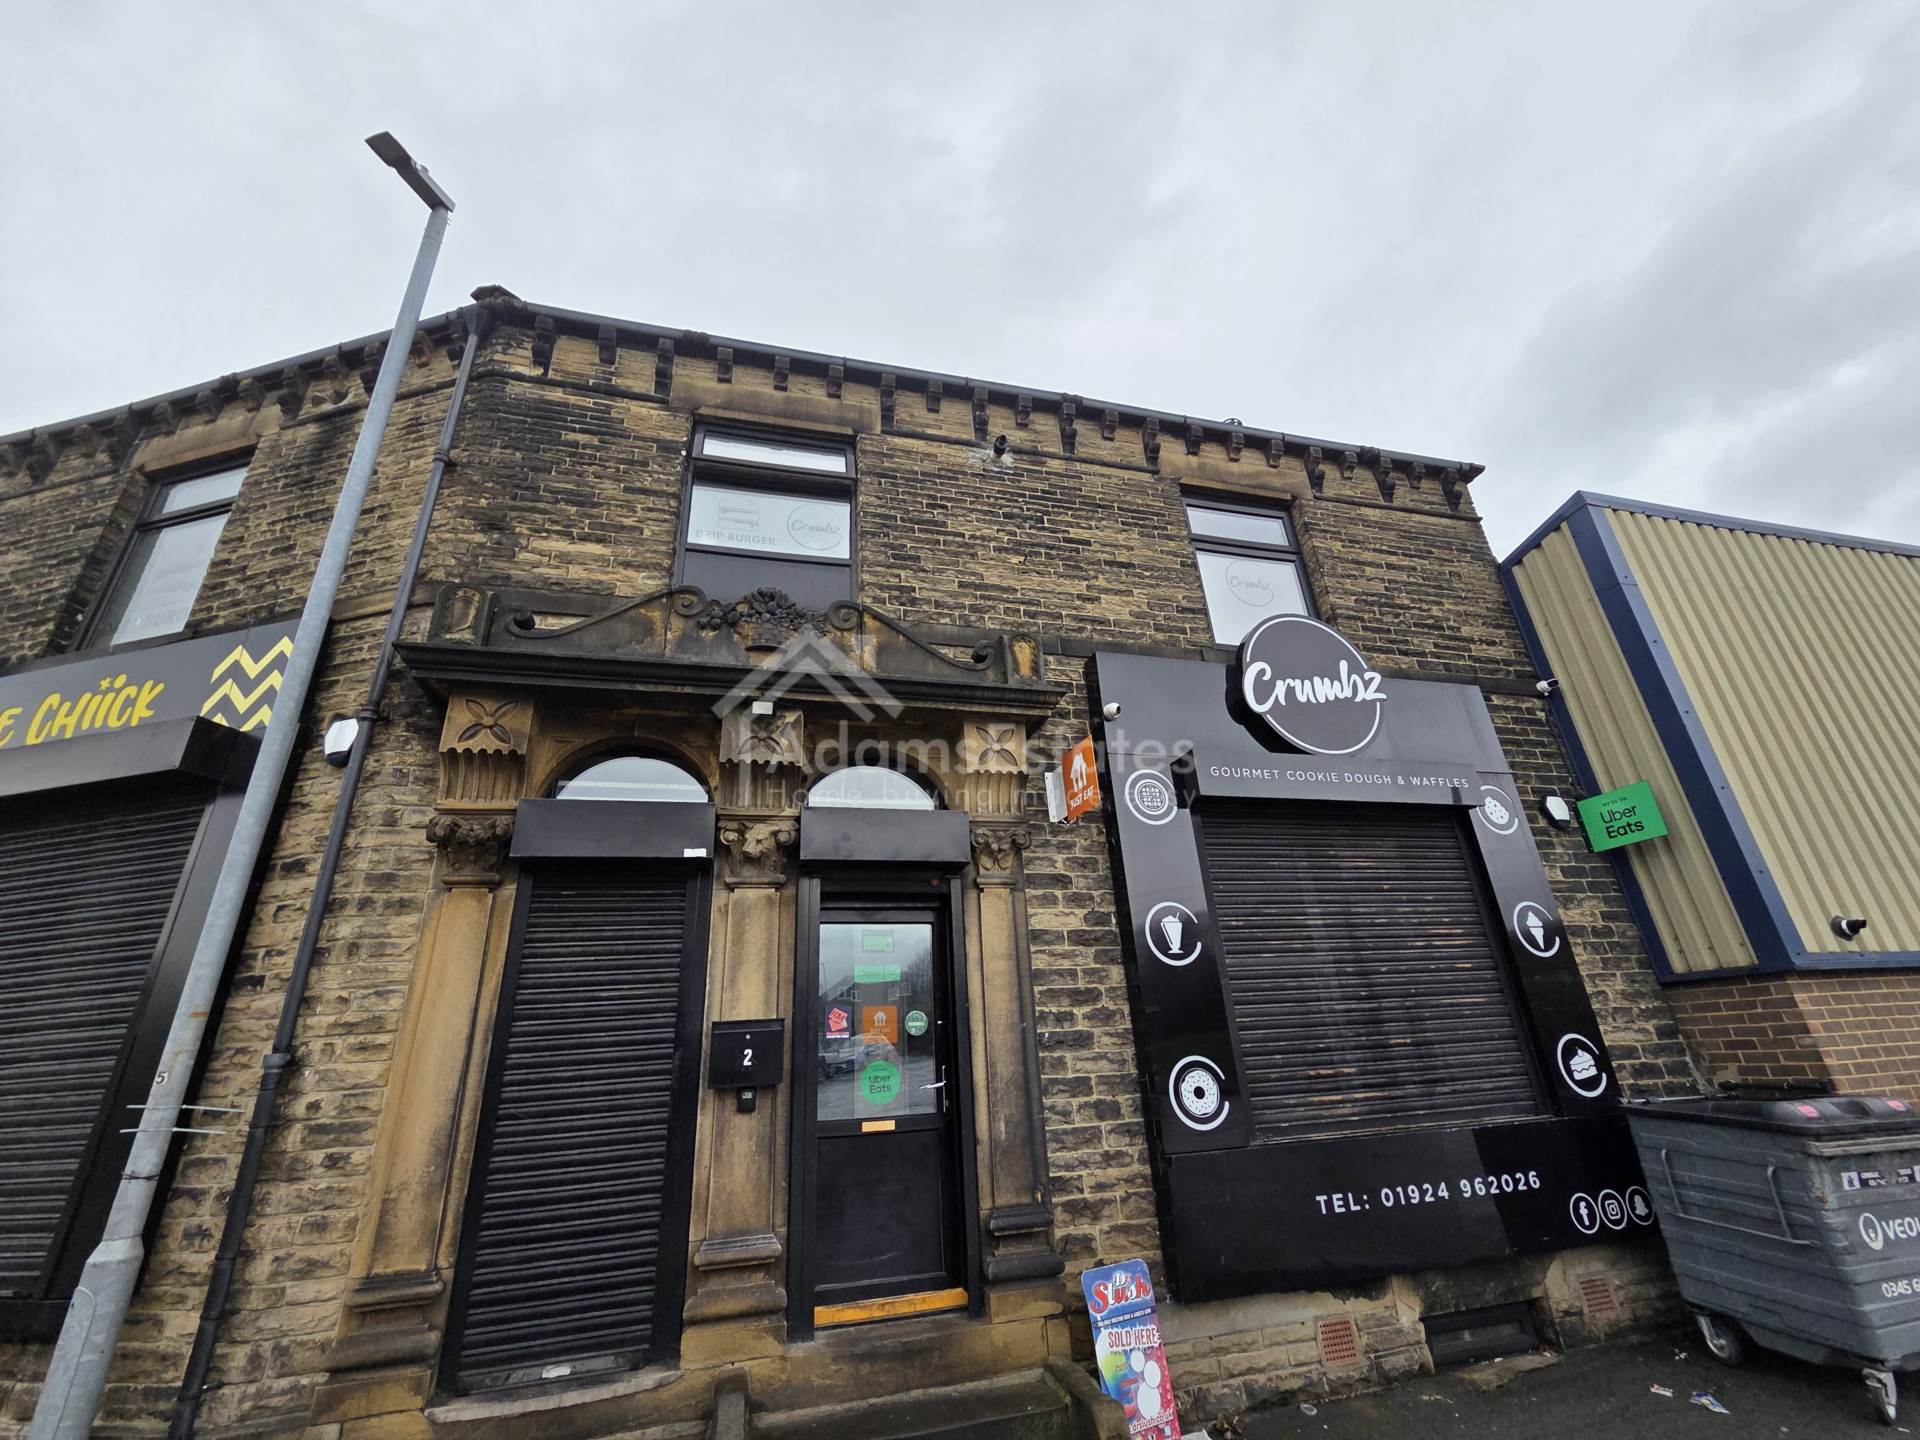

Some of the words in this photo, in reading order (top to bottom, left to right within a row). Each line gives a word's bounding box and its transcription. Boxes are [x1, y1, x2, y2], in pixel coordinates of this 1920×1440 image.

[727, 532, 777, 546] BURGER
[1244, 659, 1387, 713] Crumbz
[1210, 766, 1280, 780] GOURMET
[1286, 770, 1340, 783] COOKIE
[1344, 772, 1392, 785] DOUGH
[1396, 775, 1405, 786] &
[1409, 775, 1470, 788] WAFFLES
[1070, 793, 1083, 811] JUST
[1083, 785, 1094, 801] EAT
[1600, 805, 1637, 824] Uber
[1604, 820, 1645, 840] Eats
[743, 1048, 753, 1066] 2
[155, 1071, 166, 1085] 5
[868, 1075, 891, 1084] Uber
[869, 1084, 892, 1095] Eats
[1315, 1192, 1371, 1215] TEL:
[1380, 1181, 1450, 1208] 01924
[1459, 1170, 1541, 1198] 962026
[1090, 1275, 1150, 1314] Slush
[1882, 1280, 1912, 1298] 0345
[1108, 1330, 1132, 1349] SOLD
[1134, 1327, 1157, 1346] HERE
